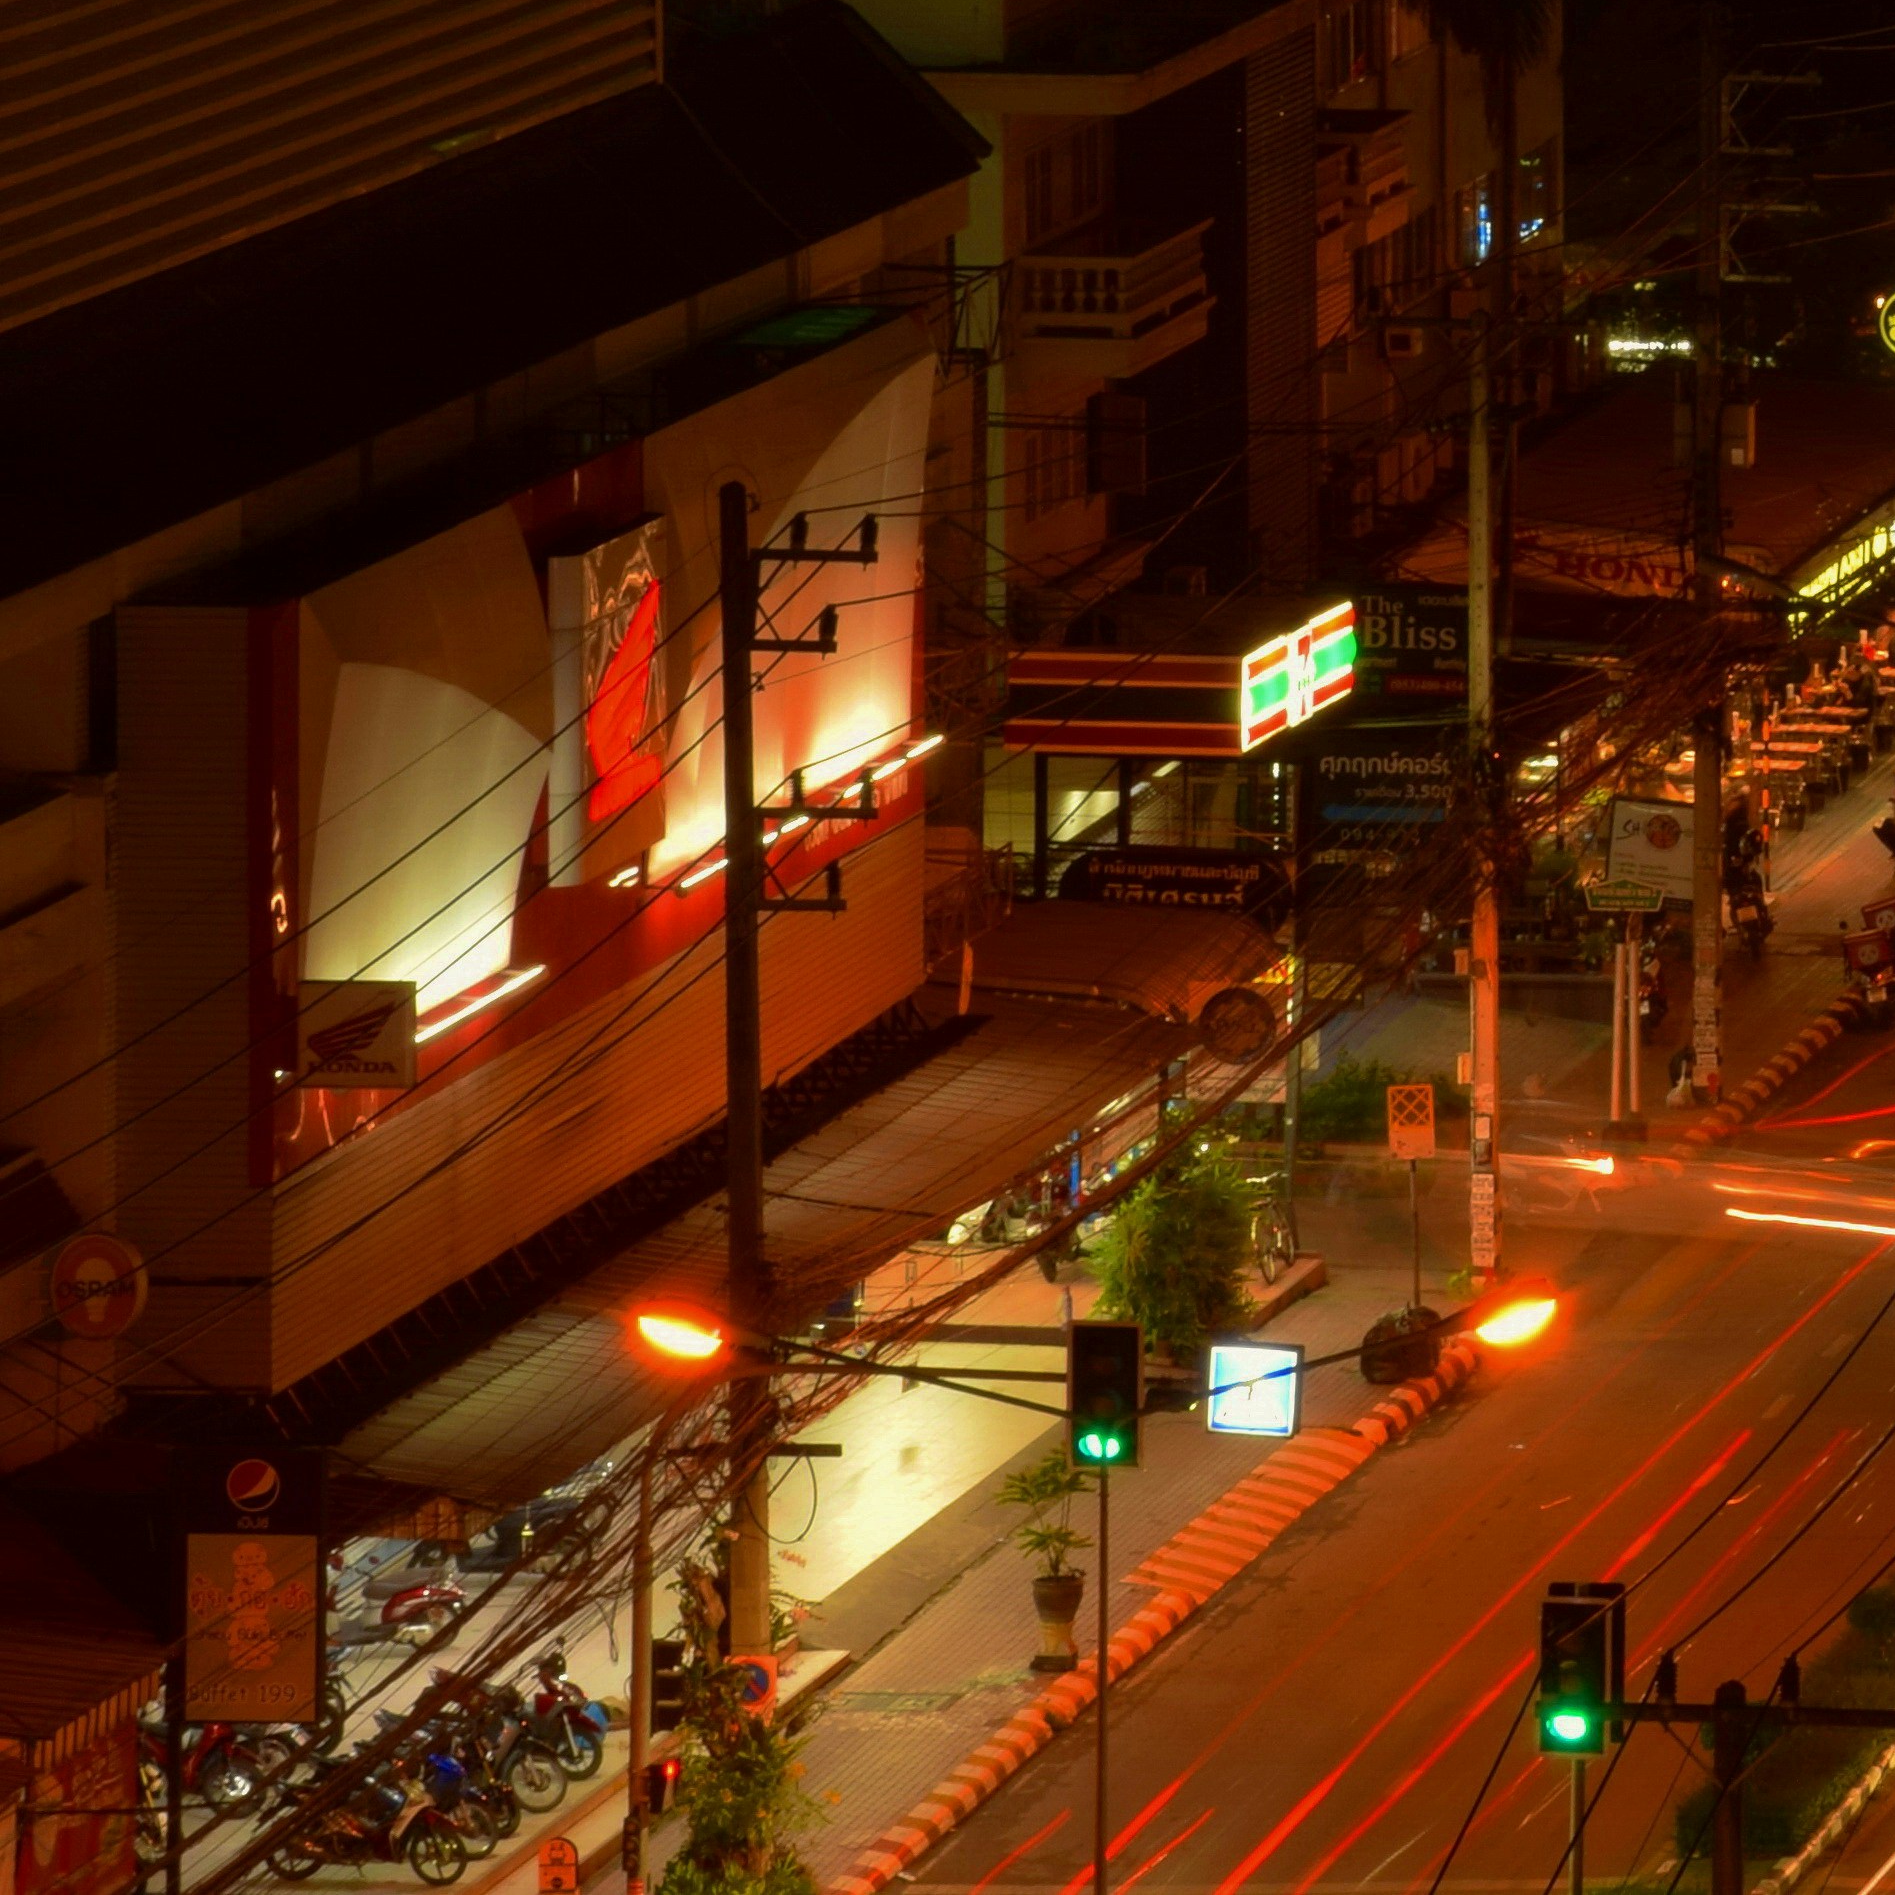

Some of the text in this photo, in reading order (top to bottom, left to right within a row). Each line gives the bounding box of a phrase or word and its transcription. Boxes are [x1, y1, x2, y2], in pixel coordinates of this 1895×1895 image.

[1361, 595, 1404, 615] The
[1362, 615, 1458, 651] Bliss
[309, 1061, 398, 1074] HONDA
[56, 1279, 136, 1299] OSRAM
[258, 1682, 296, 1704] 199
